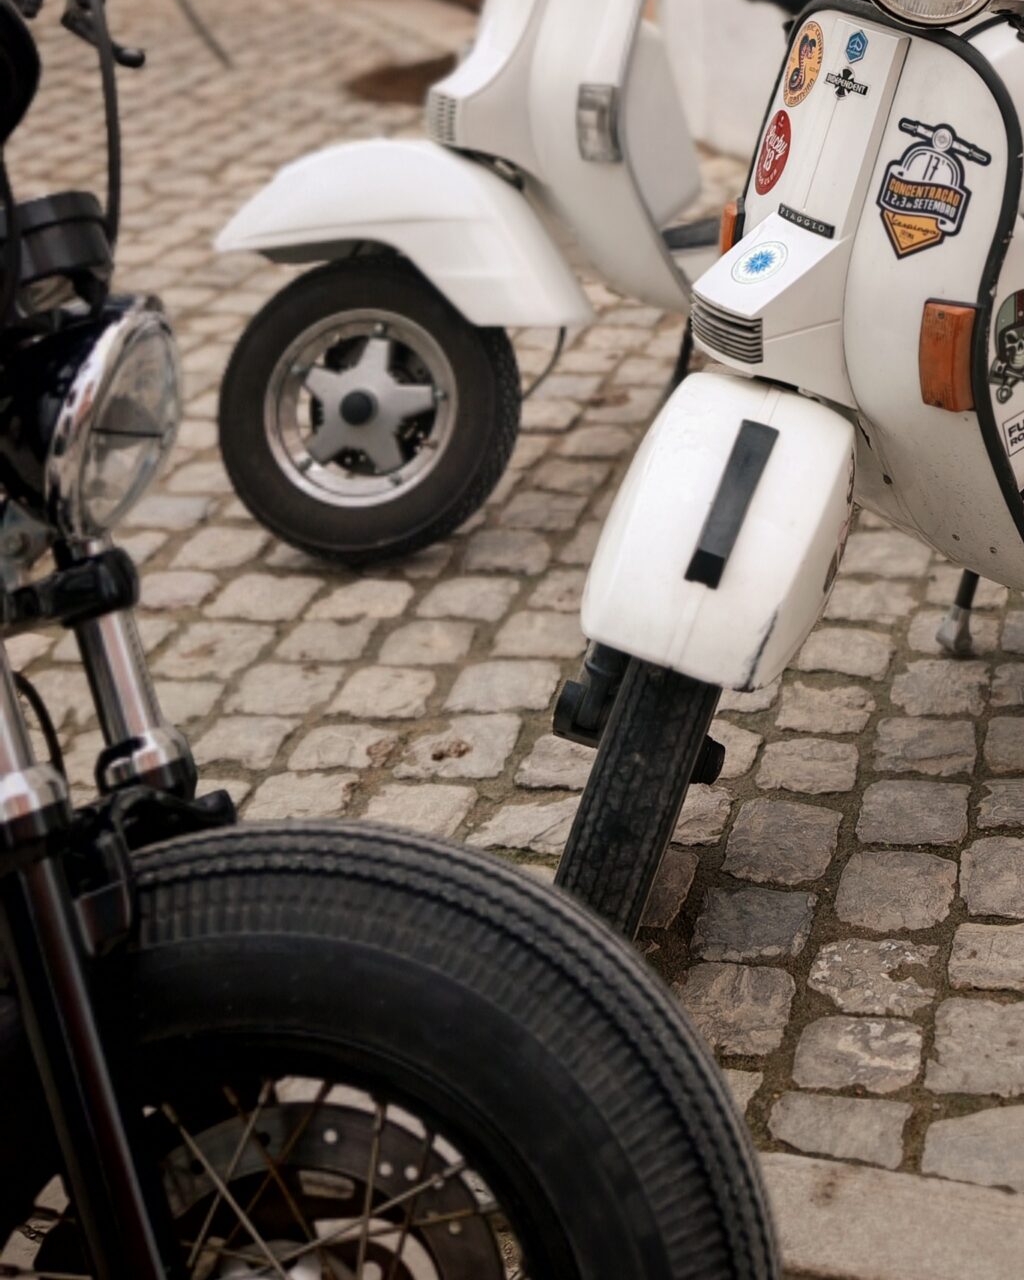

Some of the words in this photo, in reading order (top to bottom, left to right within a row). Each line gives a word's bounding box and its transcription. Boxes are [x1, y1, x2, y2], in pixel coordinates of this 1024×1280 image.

[826, 73, 867, 95] INDEPENDENT
[912, 198, 957, 218] SETEMBRO
[780, 206, 826, 233] PIAGGIO
